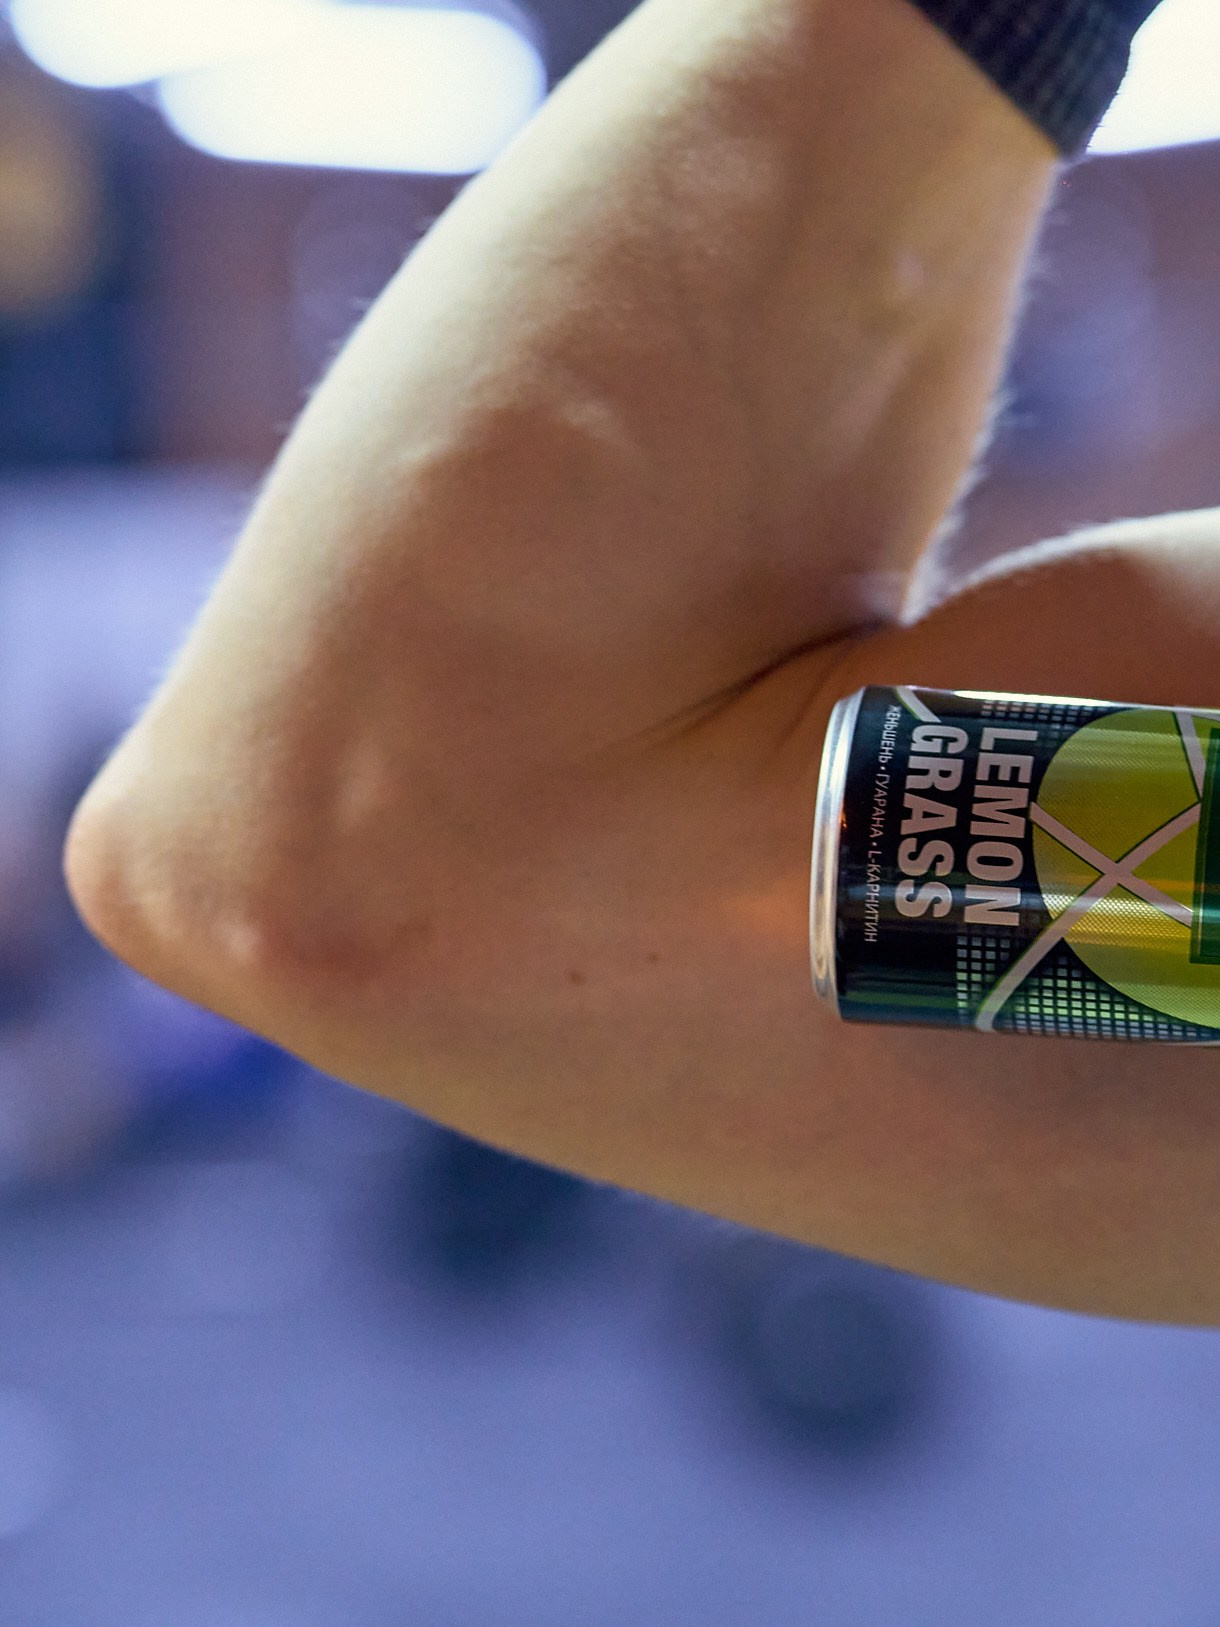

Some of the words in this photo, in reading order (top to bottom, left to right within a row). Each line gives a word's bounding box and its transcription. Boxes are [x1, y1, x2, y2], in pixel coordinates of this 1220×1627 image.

[869, 773, 891, 838] ГУАРАНА
[895, 724, 969, 918] GRASS
[964, 727, 1038, 926] LEMON
[864, 850, 882, 943] L-КАРНИТИН
